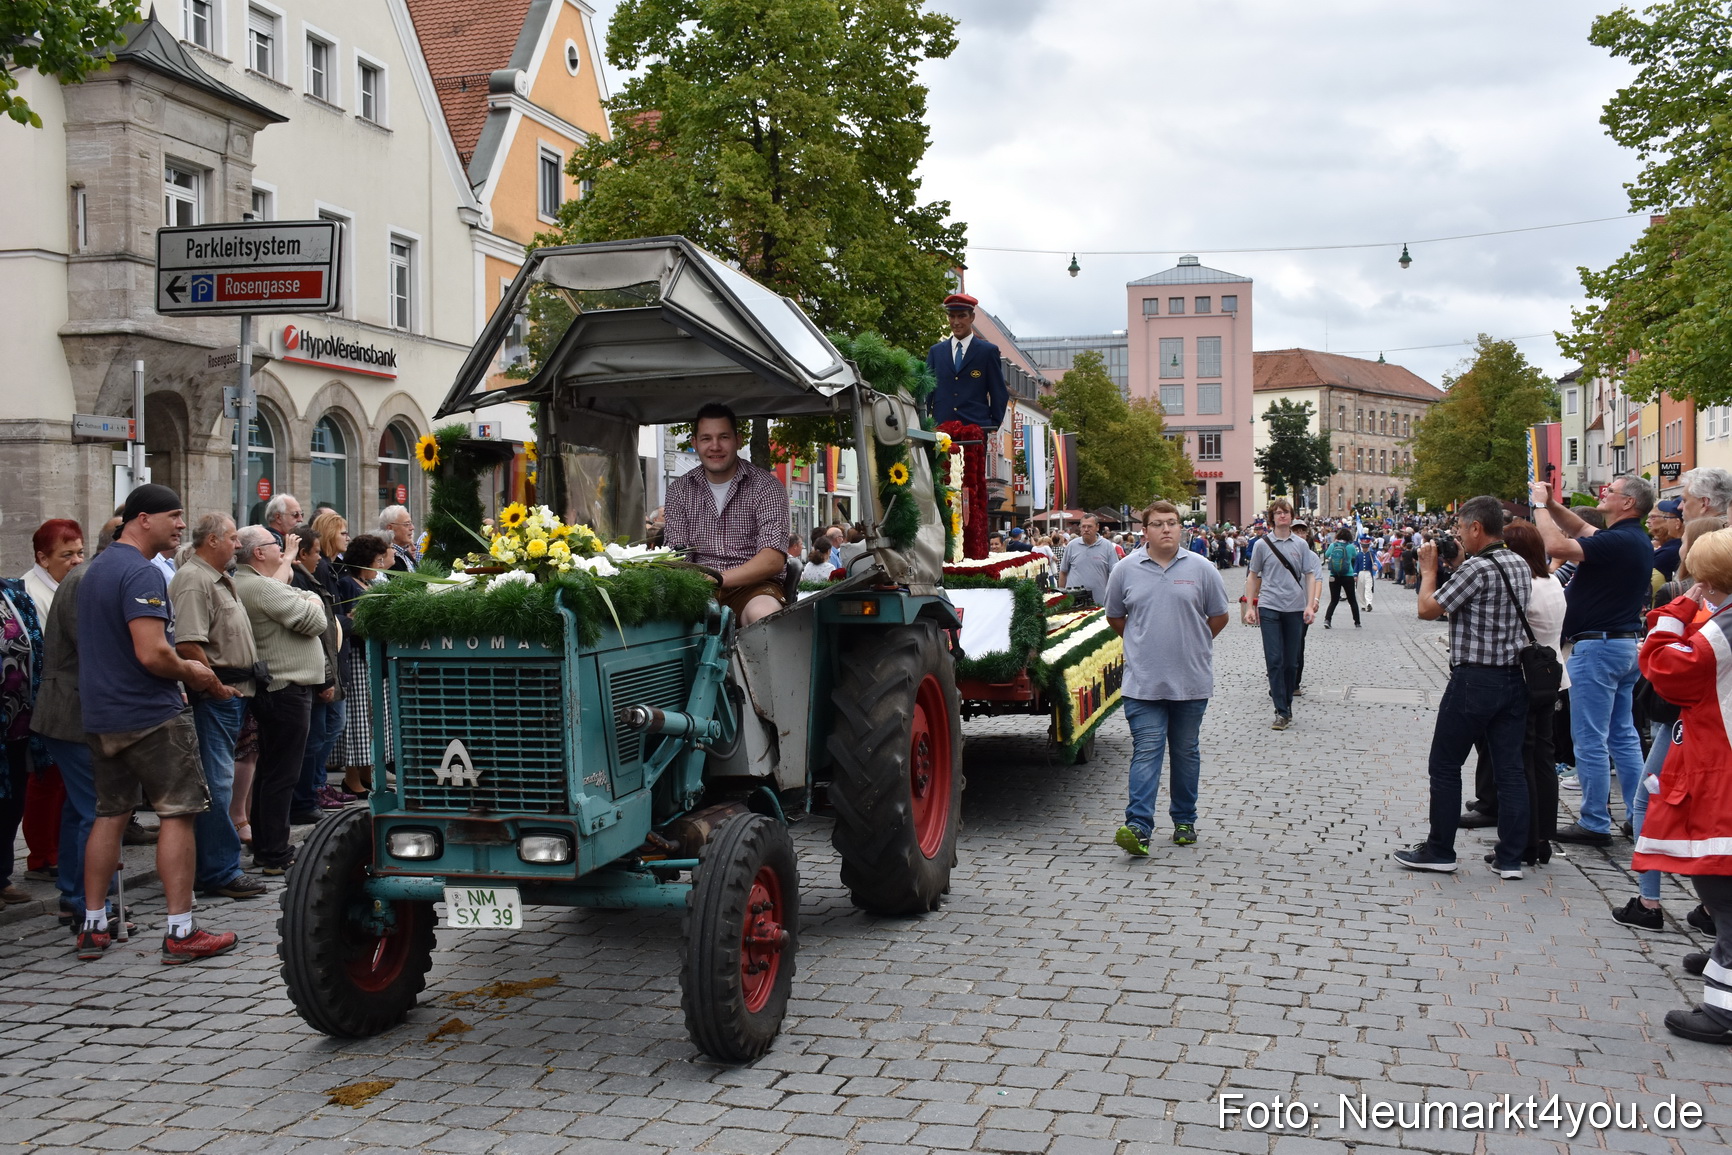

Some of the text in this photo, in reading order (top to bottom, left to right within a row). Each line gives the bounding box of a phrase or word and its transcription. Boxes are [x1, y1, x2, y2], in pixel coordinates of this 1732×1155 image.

[186, 236, 301, 262] Parkleitsystem
[225, 277, 300, 298] Rosengasse
[300, 329, 397, 368] HypoVereinsbank
[1193, 469, 1224, 478] rkasse
[466, 890, 497, 906] NM
[457, 908, 513, 926] SX 39
